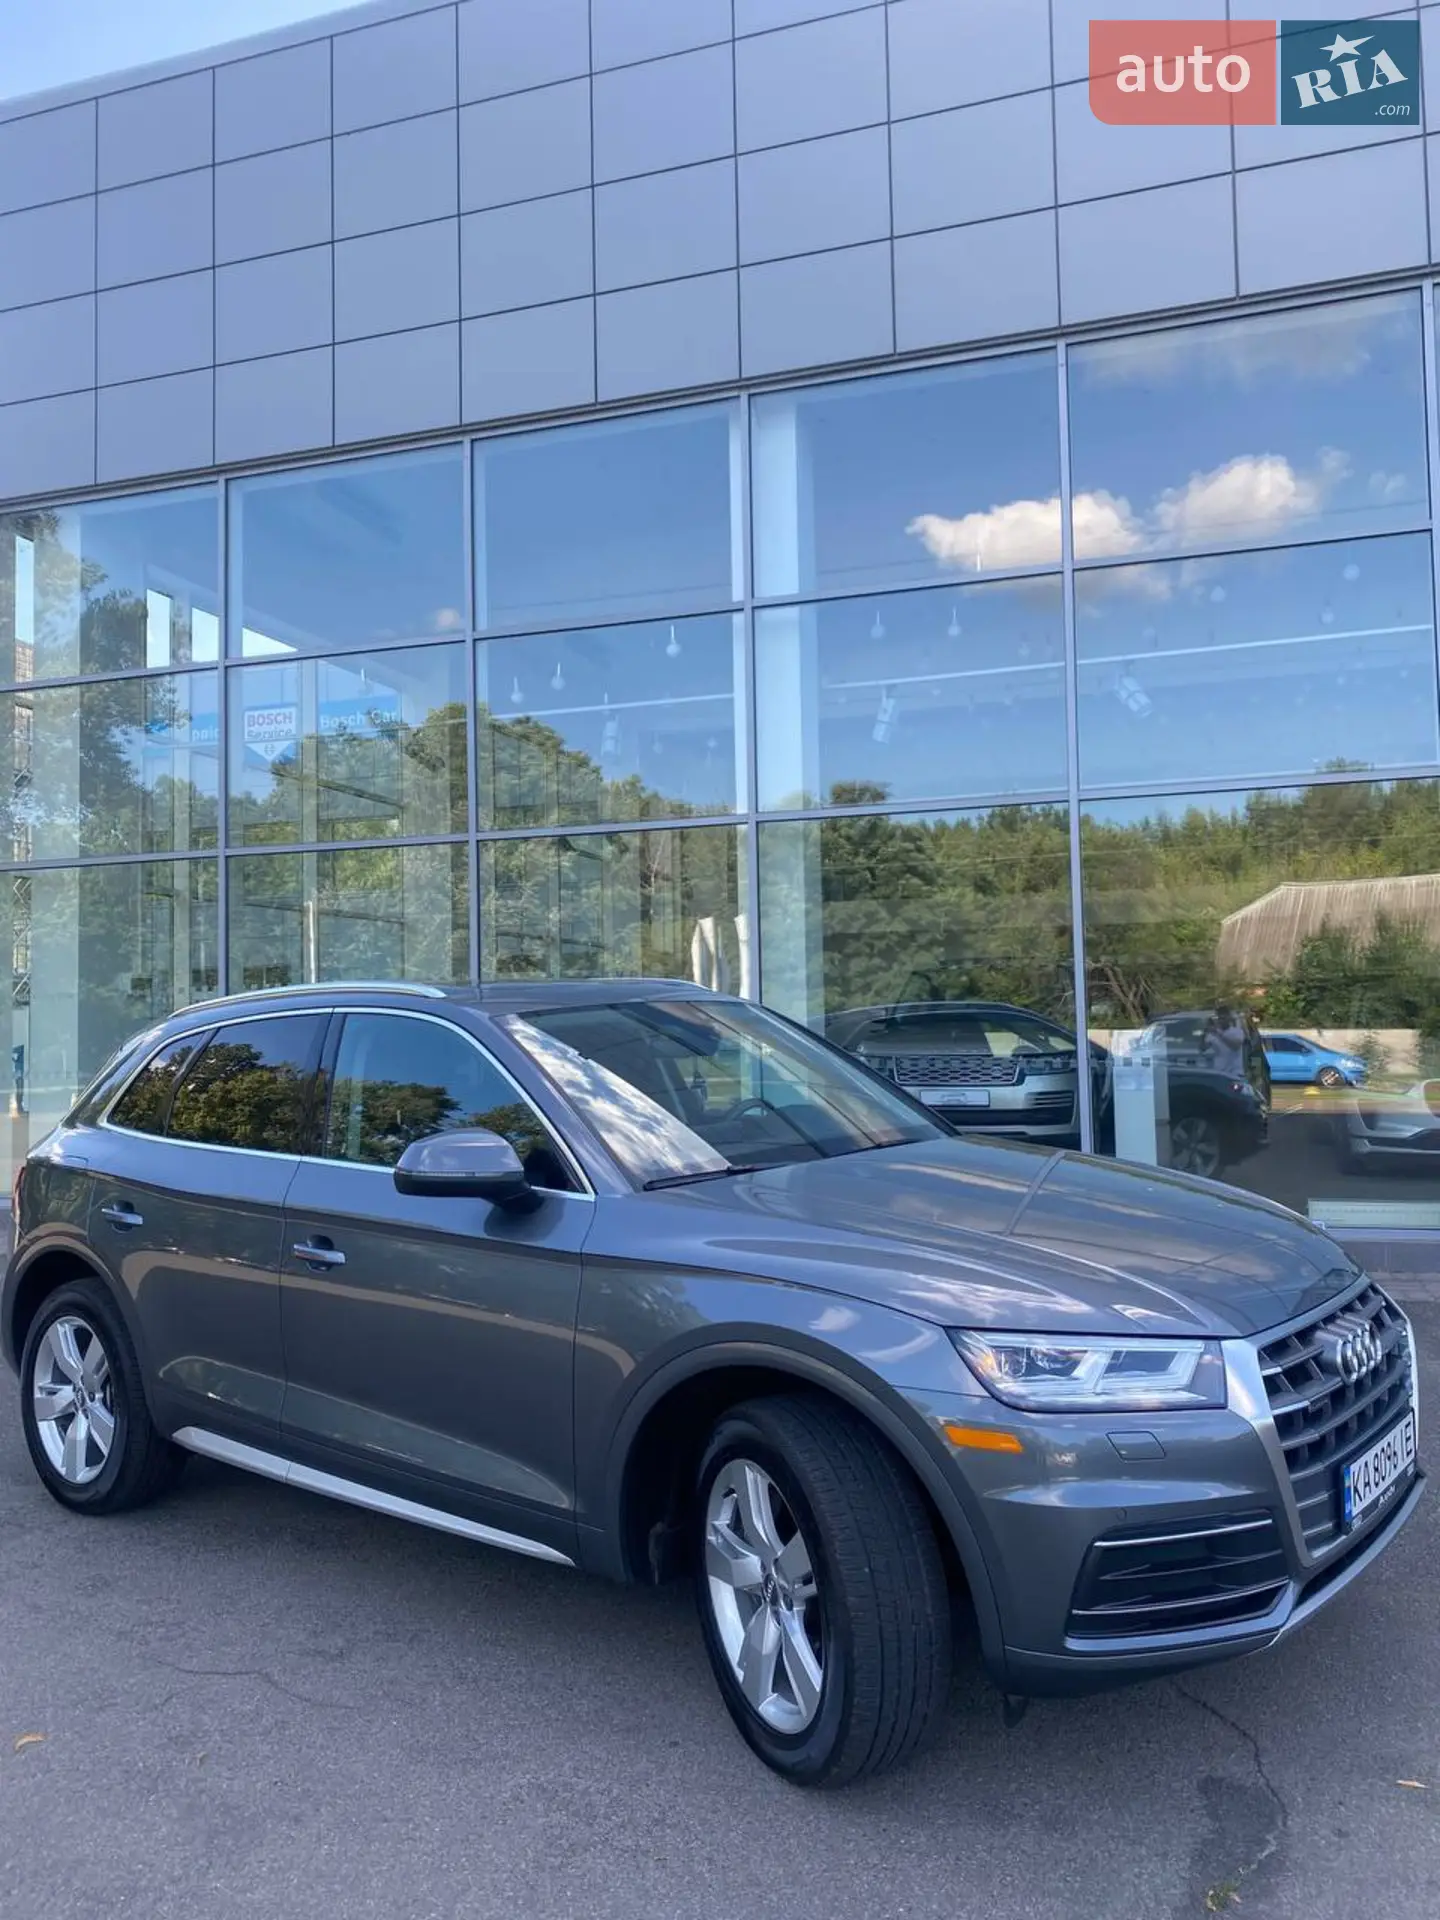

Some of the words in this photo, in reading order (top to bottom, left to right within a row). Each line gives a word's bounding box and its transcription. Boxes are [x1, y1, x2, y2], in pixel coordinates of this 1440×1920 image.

[247, 711, 292, 727] BOSCH
[320, 711, 364, 728] Bosch
[247, 727, 292, 740] Service
